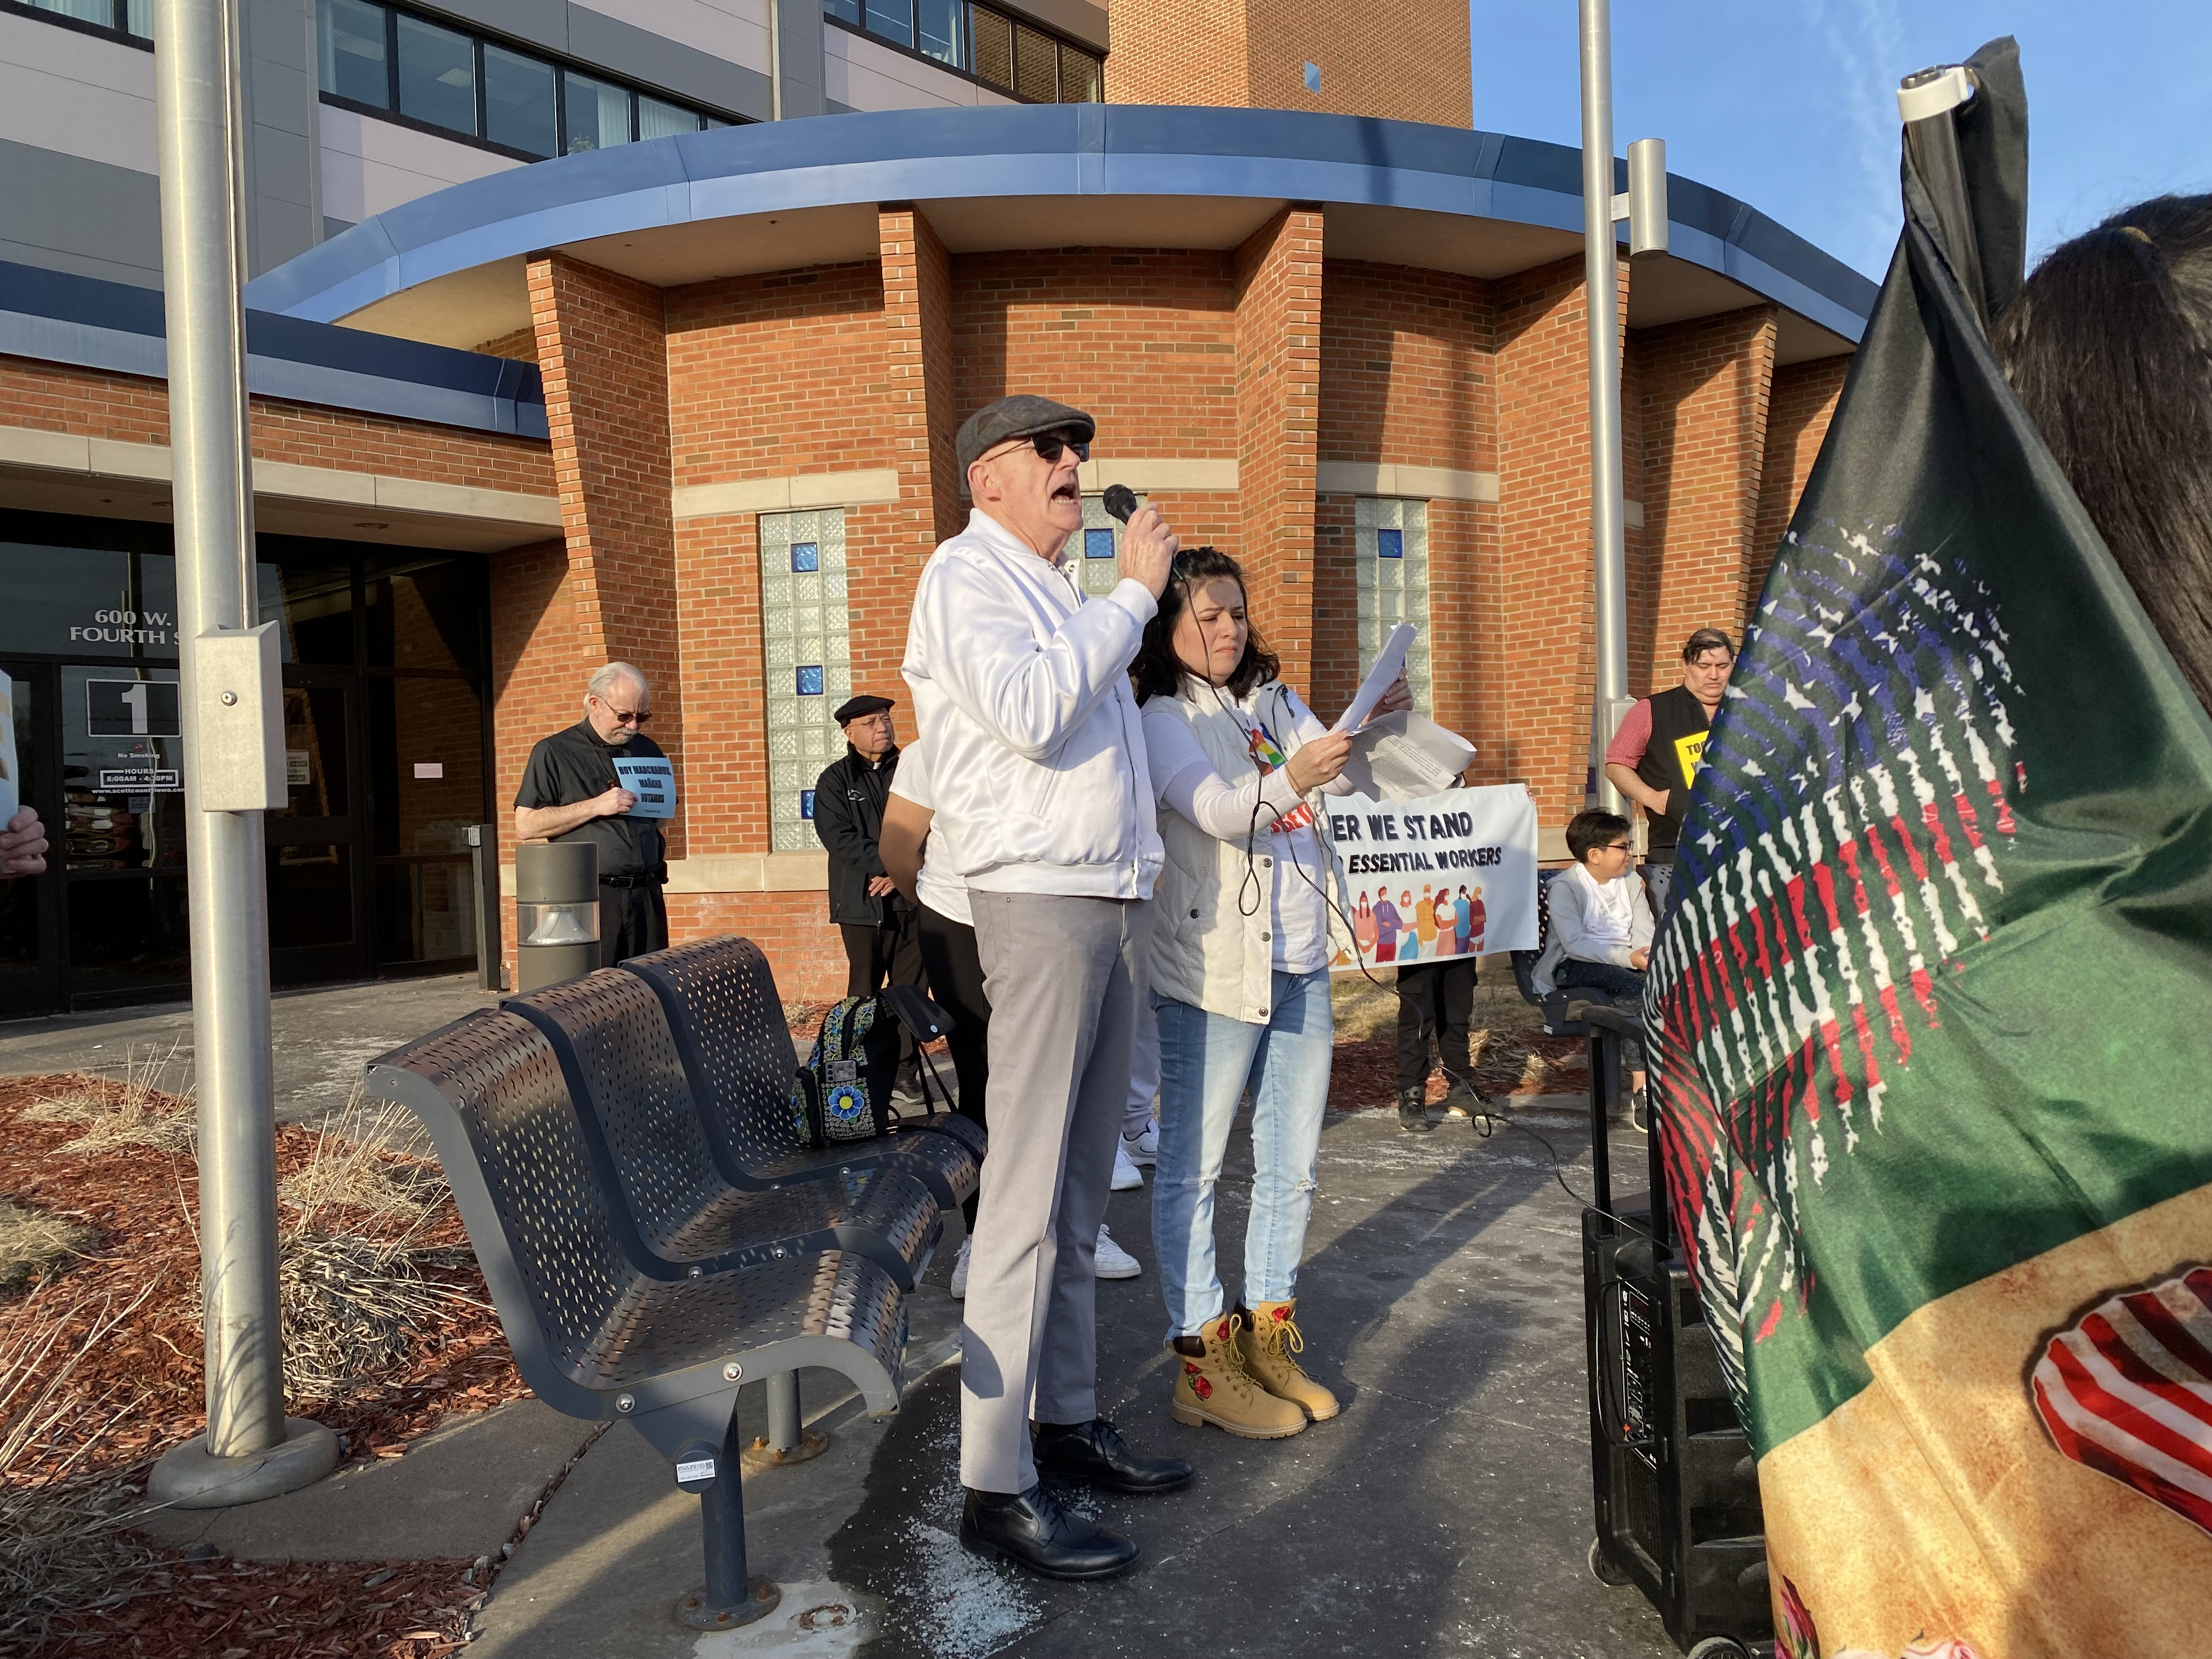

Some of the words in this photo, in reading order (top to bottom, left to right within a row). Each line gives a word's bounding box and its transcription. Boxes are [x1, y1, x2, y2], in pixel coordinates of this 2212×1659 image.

[95, 610, 137, 624] 600
[143, 612, 172, 627] W.
[70, 627, 165, 644] FOURTH
[122, 684, 148, 733] 1
[618, 766, 633, 775] HOY
[638, 778, 663, 789] MAÑANA
[641, 793, 664, 803] VOTAMOS
[1328, 814, 1362, 843] ER
[1367, 814, 1400, 842] WE
[1404, 811, 1474, 840] STAND
[1348, 852, 1436, 874] ESSENTIAL
[1435, 846, 1502, 870] WORKERS
[678, 1463, 706, 1471] PARIS
